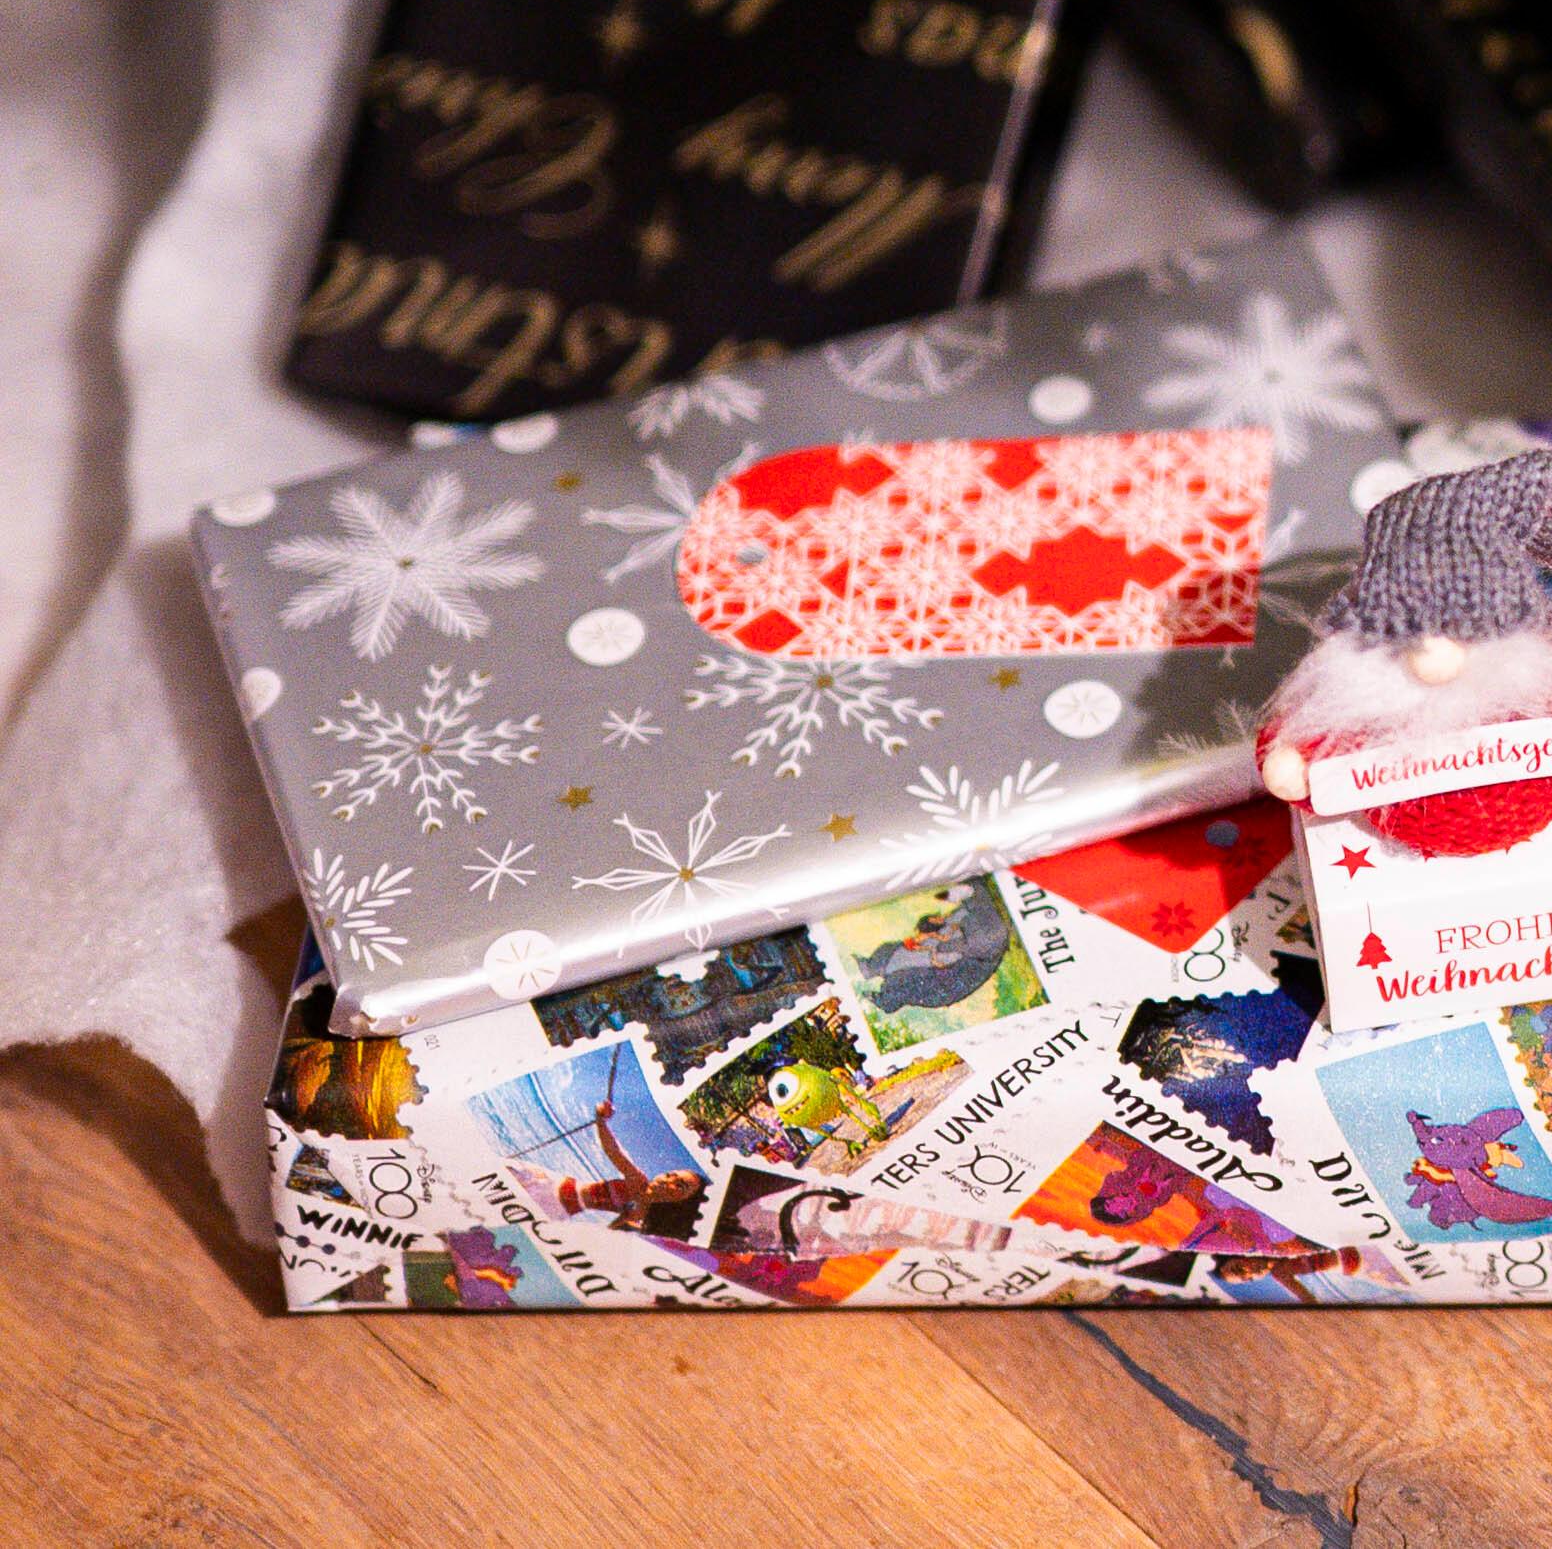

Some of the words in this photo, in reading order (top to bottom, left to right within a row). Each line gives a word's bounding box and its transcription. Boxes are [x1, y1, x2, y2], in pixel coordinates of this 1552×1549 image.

[1038, 927, 1076, 974] The
[871, 1142, 941, 1190] TERS
[934, 1019, 1090, 1145] UNIVERSITY
[1102, 1073, 1284, 1193] Aladdin
[366, 1148, 419, 1220] 100
